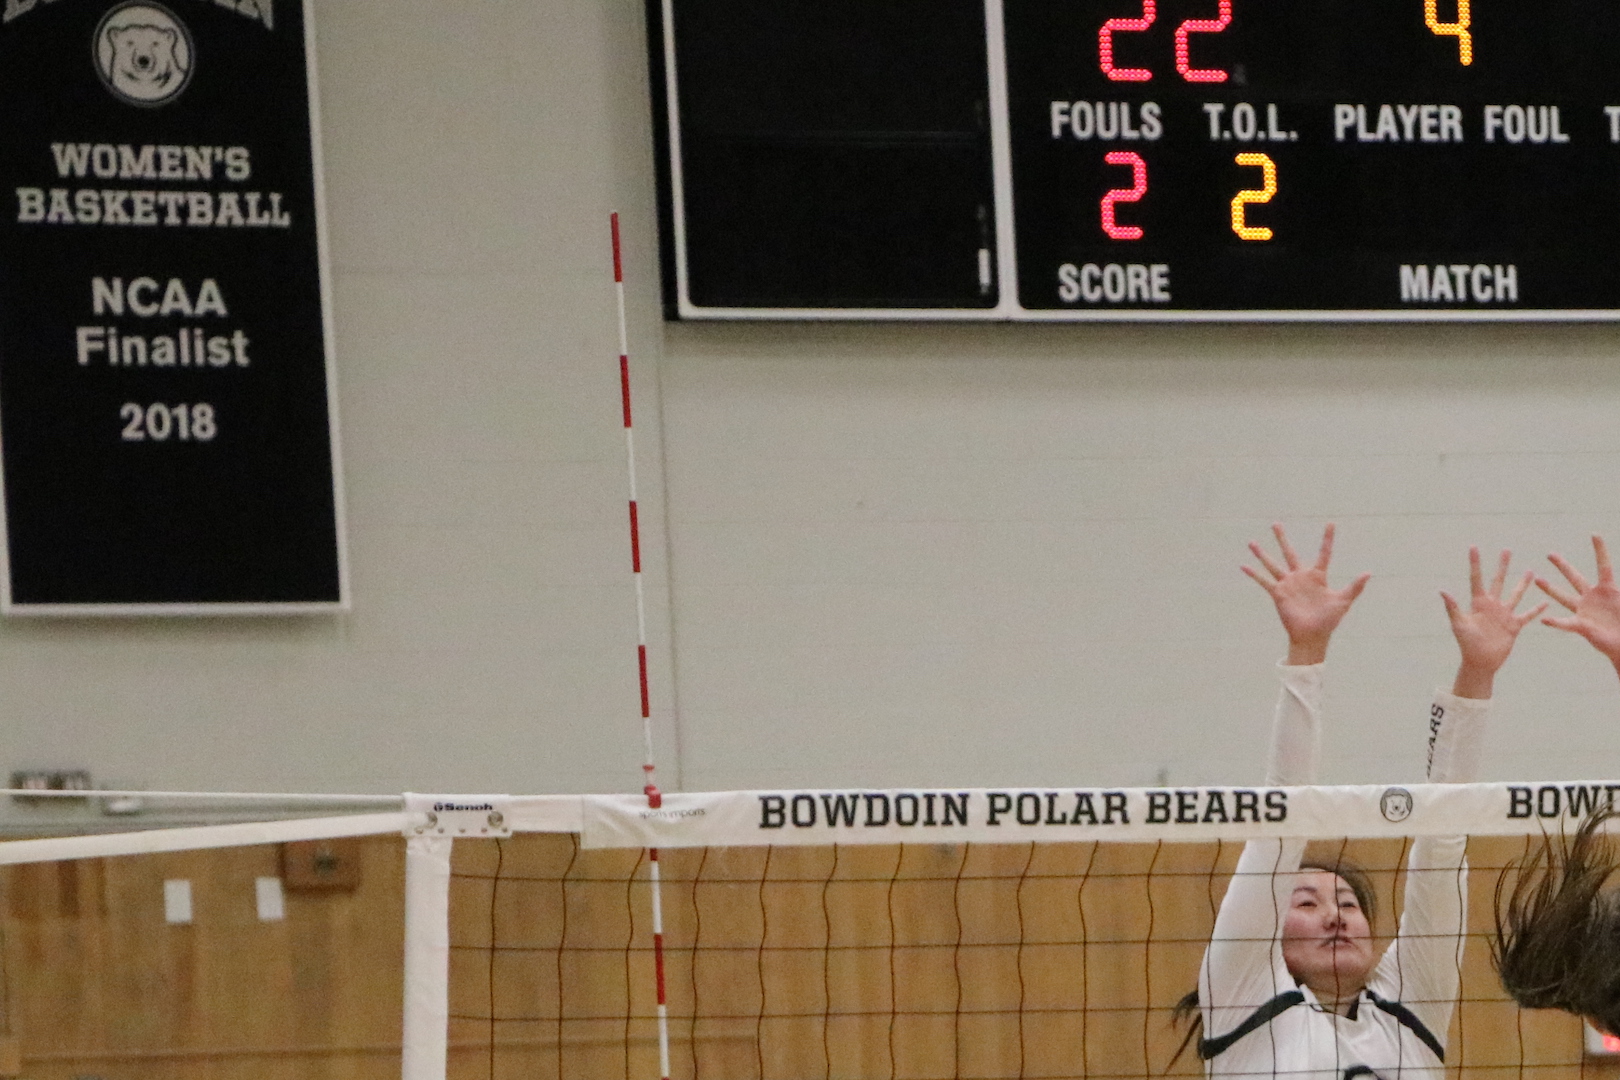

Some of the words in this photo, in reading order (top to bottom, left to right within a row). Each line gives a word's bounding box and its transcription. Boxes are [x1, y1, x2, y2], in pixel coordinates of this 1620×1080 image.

[1099, 0, 1231, 82] 22
[1051, 101, 1162, 139] FOULS
[1204, 103, 1297, 140] T.O.L.
[1335, 104, 1462, 141] PLAYER
[1485, 105, 1569, 142] FOUL
[51, 143, 250, 181] WOMEN'S
[16, 188, 290, 227] BASKETBALL
[1101, 152, 1147, 240] 2
[1231, 153, 1276, 240] 2
[92, 277, 227, 317] NCAA
[1058, 264, 1171, 301] SCORE
[1400, 265, 1517, 301] MATCH
[76, 326, 249, 366] Finalist
[120, 403, 216, 440] 2018
[759, 794, 969, 829] BOWDOIN
[987, 792, 1130, 826] POLAR
[1145, 791, 1287, 824] BEARS
